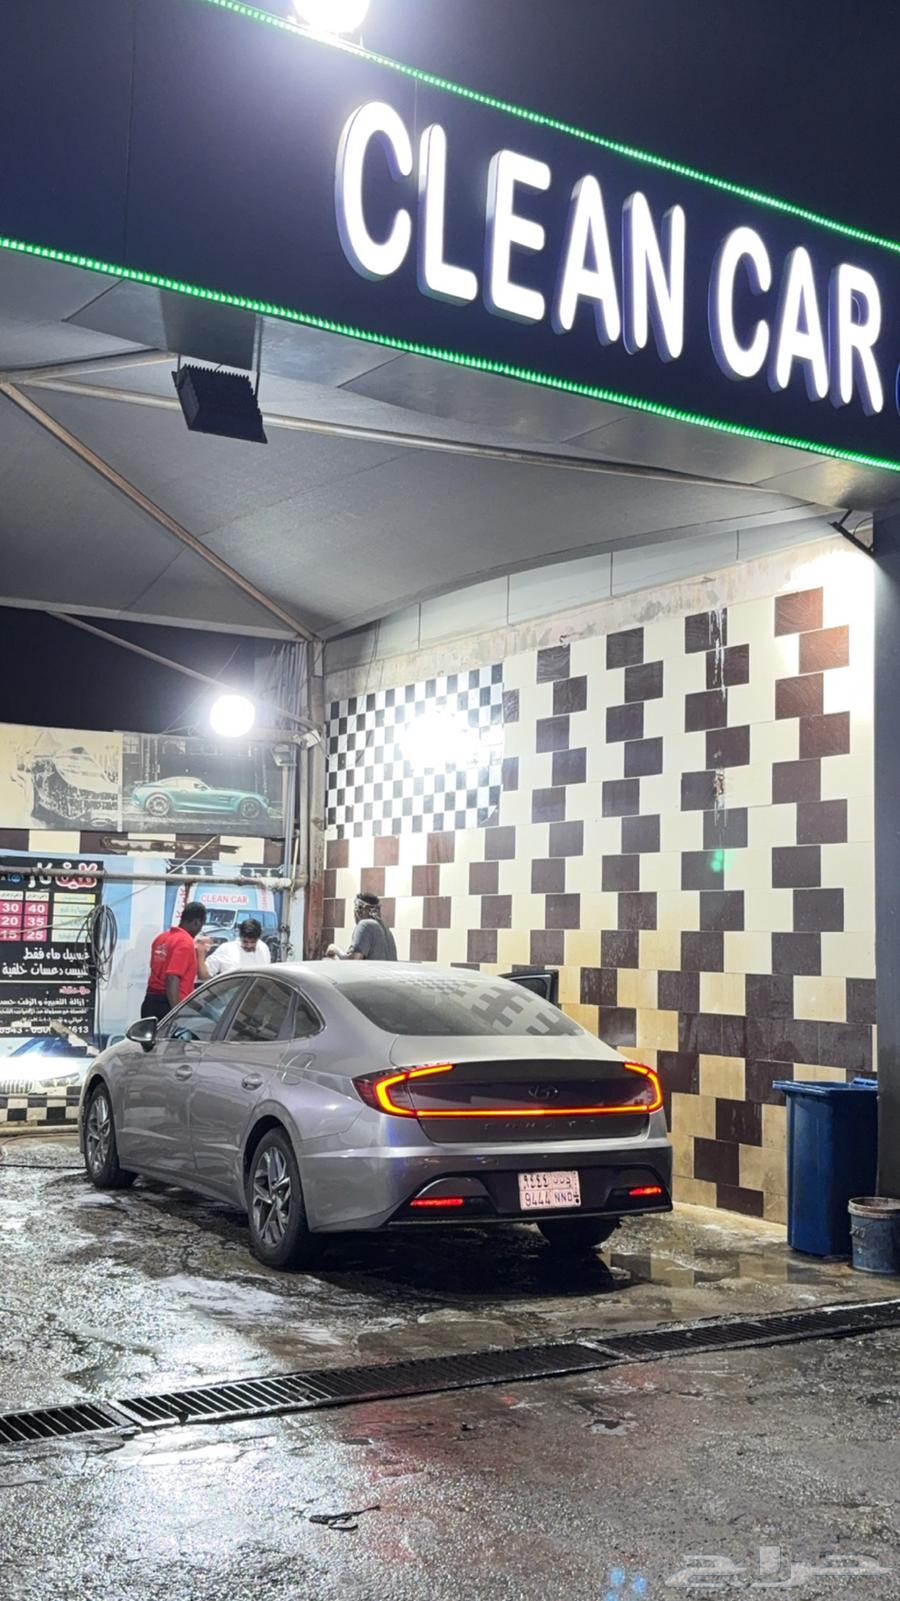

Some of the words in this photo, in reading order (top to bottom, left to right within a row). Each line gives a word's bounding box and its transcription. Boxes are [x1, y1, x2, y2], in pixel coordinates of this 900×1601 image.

[336, 101, 686, 364] CLEAN
[708, 226, 883, 417] CAR
[201, 895, 228, 904] CLEAN
[231, 896, 248, 904] CAR
[2, 903, 19, 912] 30
[28, 904, 45, 913] 40
[1, 916, 18, 926] 20
[27, 917, 44, 926] 35
[27, 931, 44, 940] 25
[23, 947, 45, 960] فقط
[46, 947, 61, 960] ماء
[2, 962, 28, 978] خلفية
[525, 1191, 551, 1206] 9444
